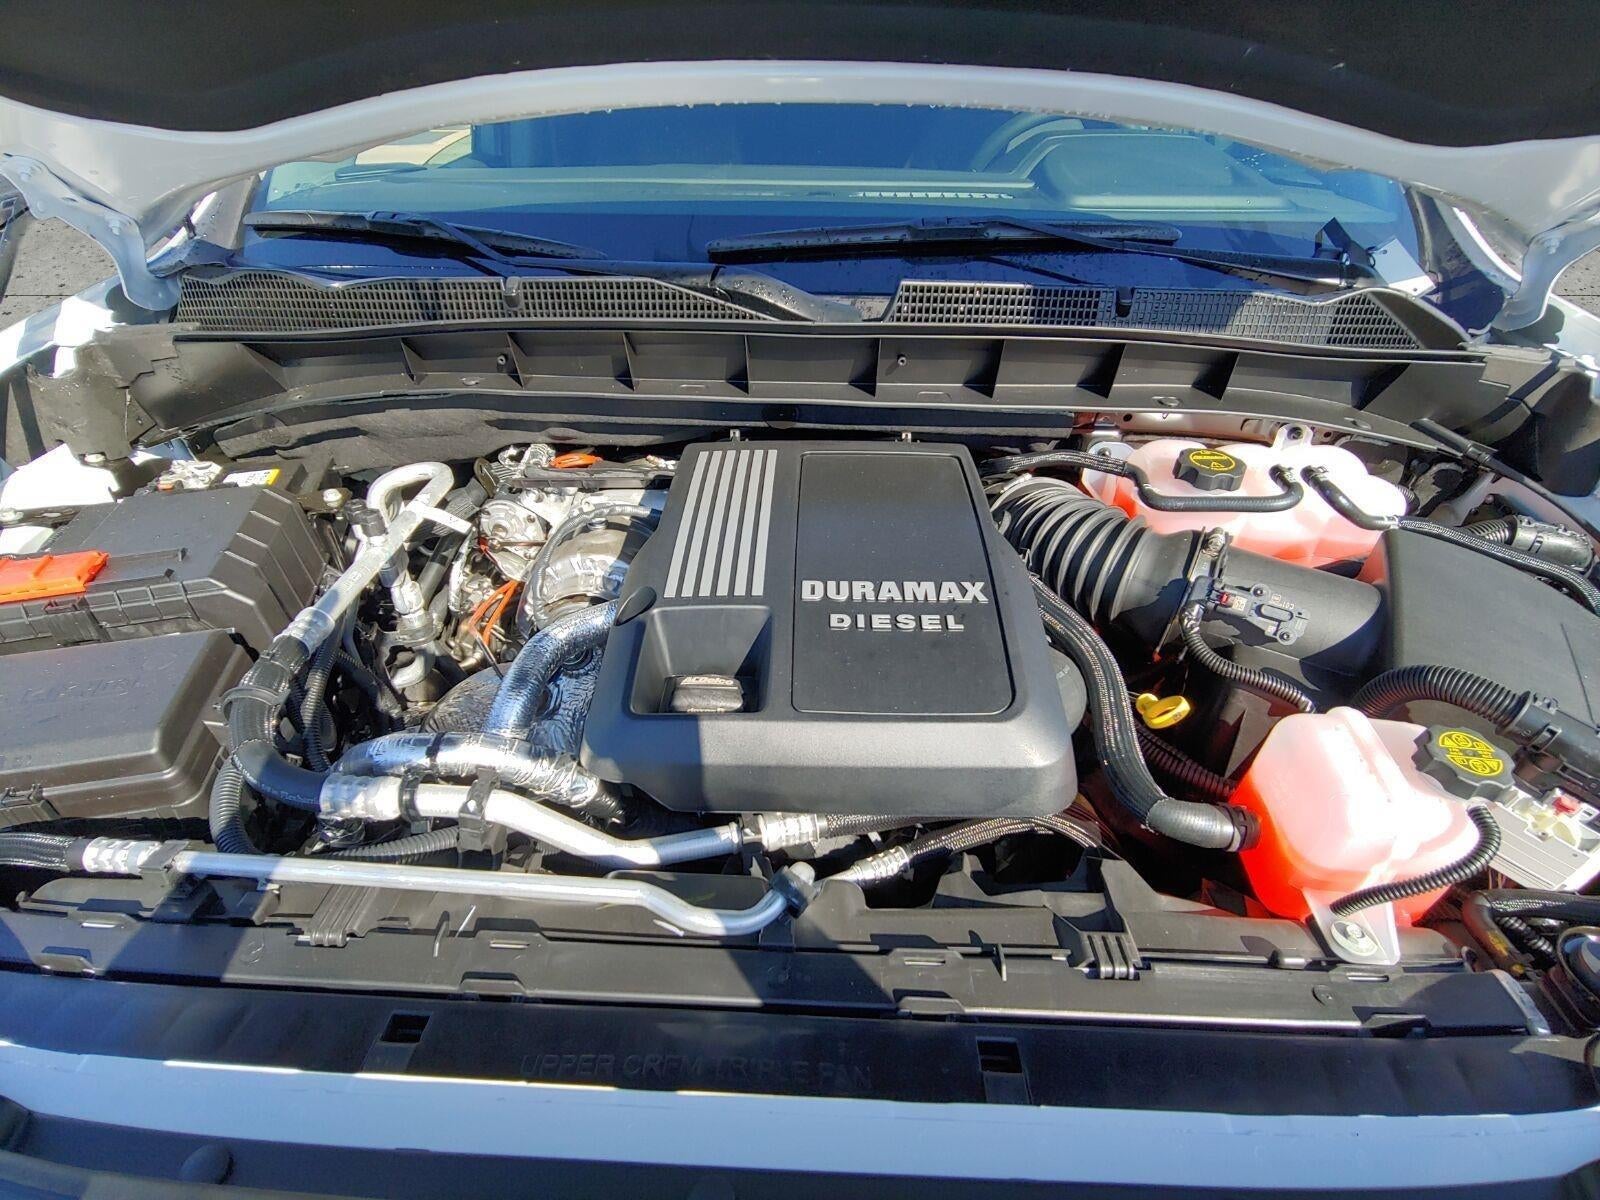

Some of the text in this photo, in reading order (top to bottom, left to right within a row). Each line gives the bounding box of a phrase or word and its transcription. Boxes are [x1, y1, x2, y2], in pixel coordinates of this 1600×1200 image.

[801, 580, 989, 604] DURAMAX
[829, 613, 965, 632] DIESEL
[680, 676, 734, 686] ACDelco
[520, 1053, 614, 1079] UPPER
[622, 1053, 704, 1080] CRFM
